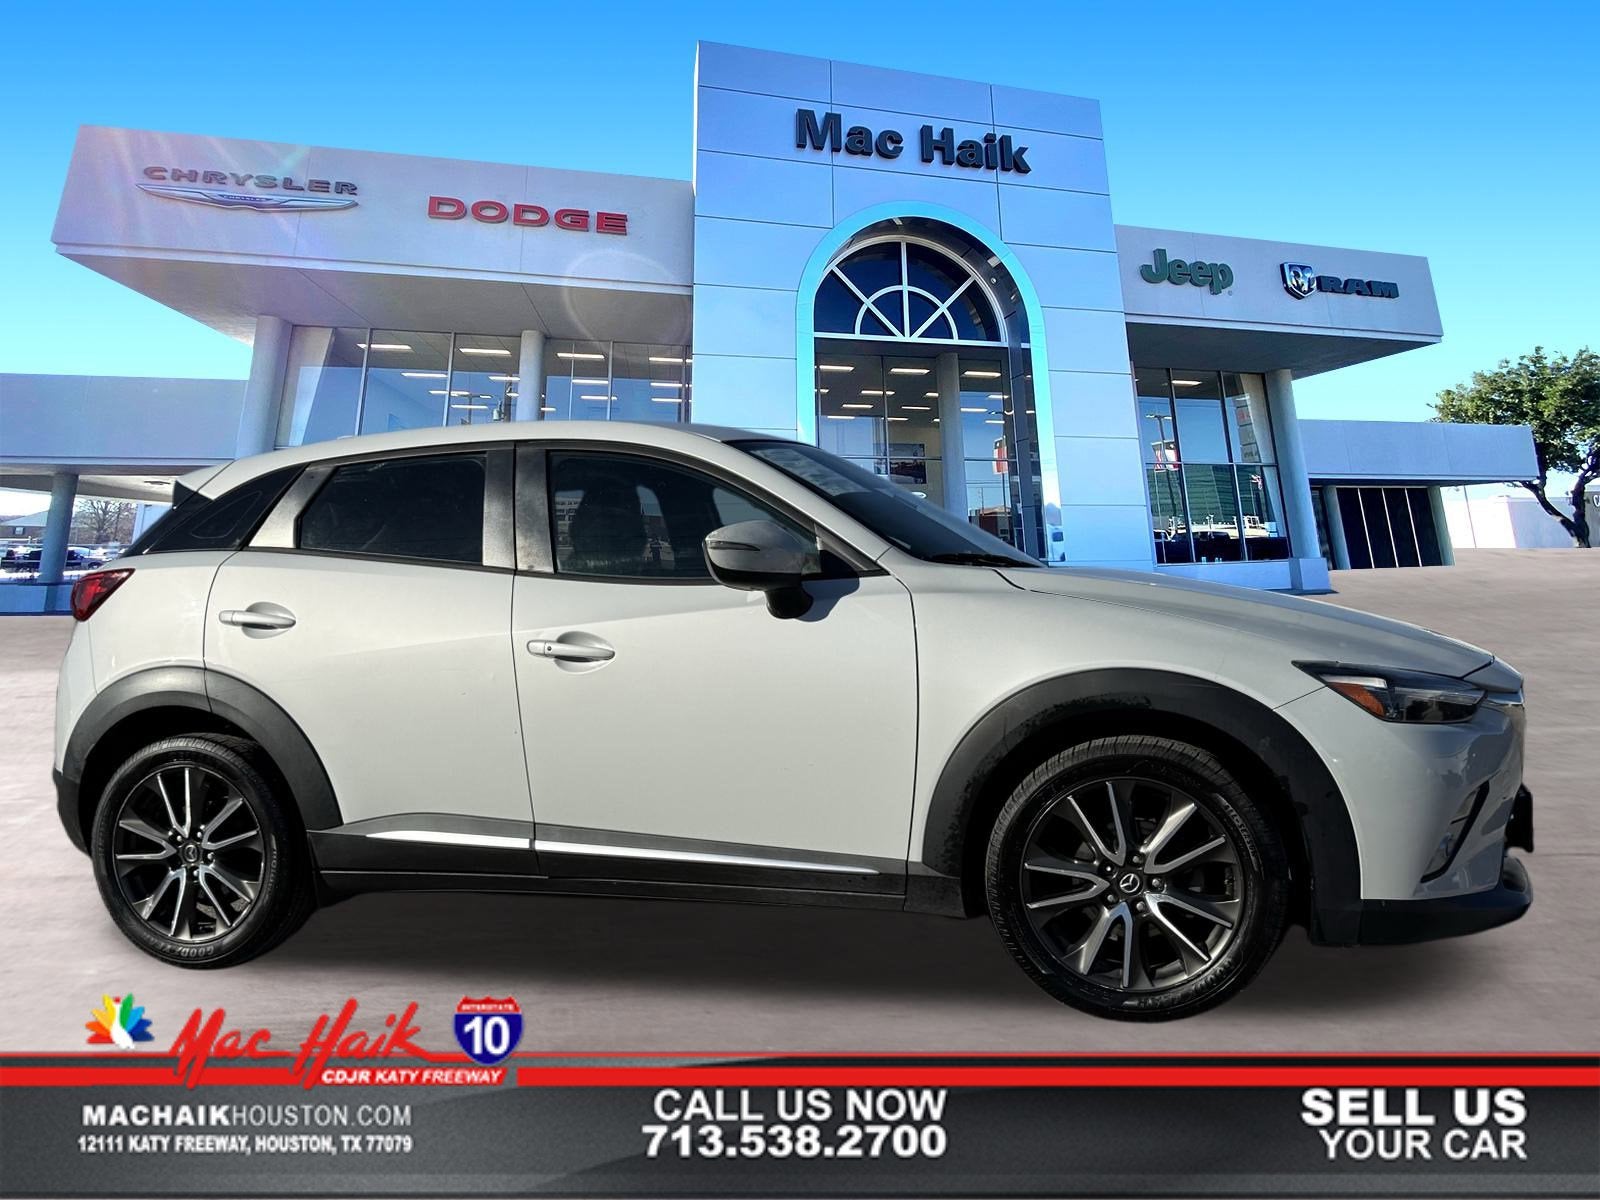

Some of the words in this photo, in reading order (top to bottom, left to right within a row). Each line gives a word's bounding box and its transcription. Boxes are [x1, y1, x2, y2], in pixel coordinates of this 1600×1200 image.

[796, 108, 904, 160] Mac
[920, 124, 1032, 174] Haik
[143, 166, 358, 196] CHRYSLER
[428, 196, 628, 236] DODGE
[1140, 248, 1234, 296] Jeep
[1315, 275, 1400, 299] RAM
